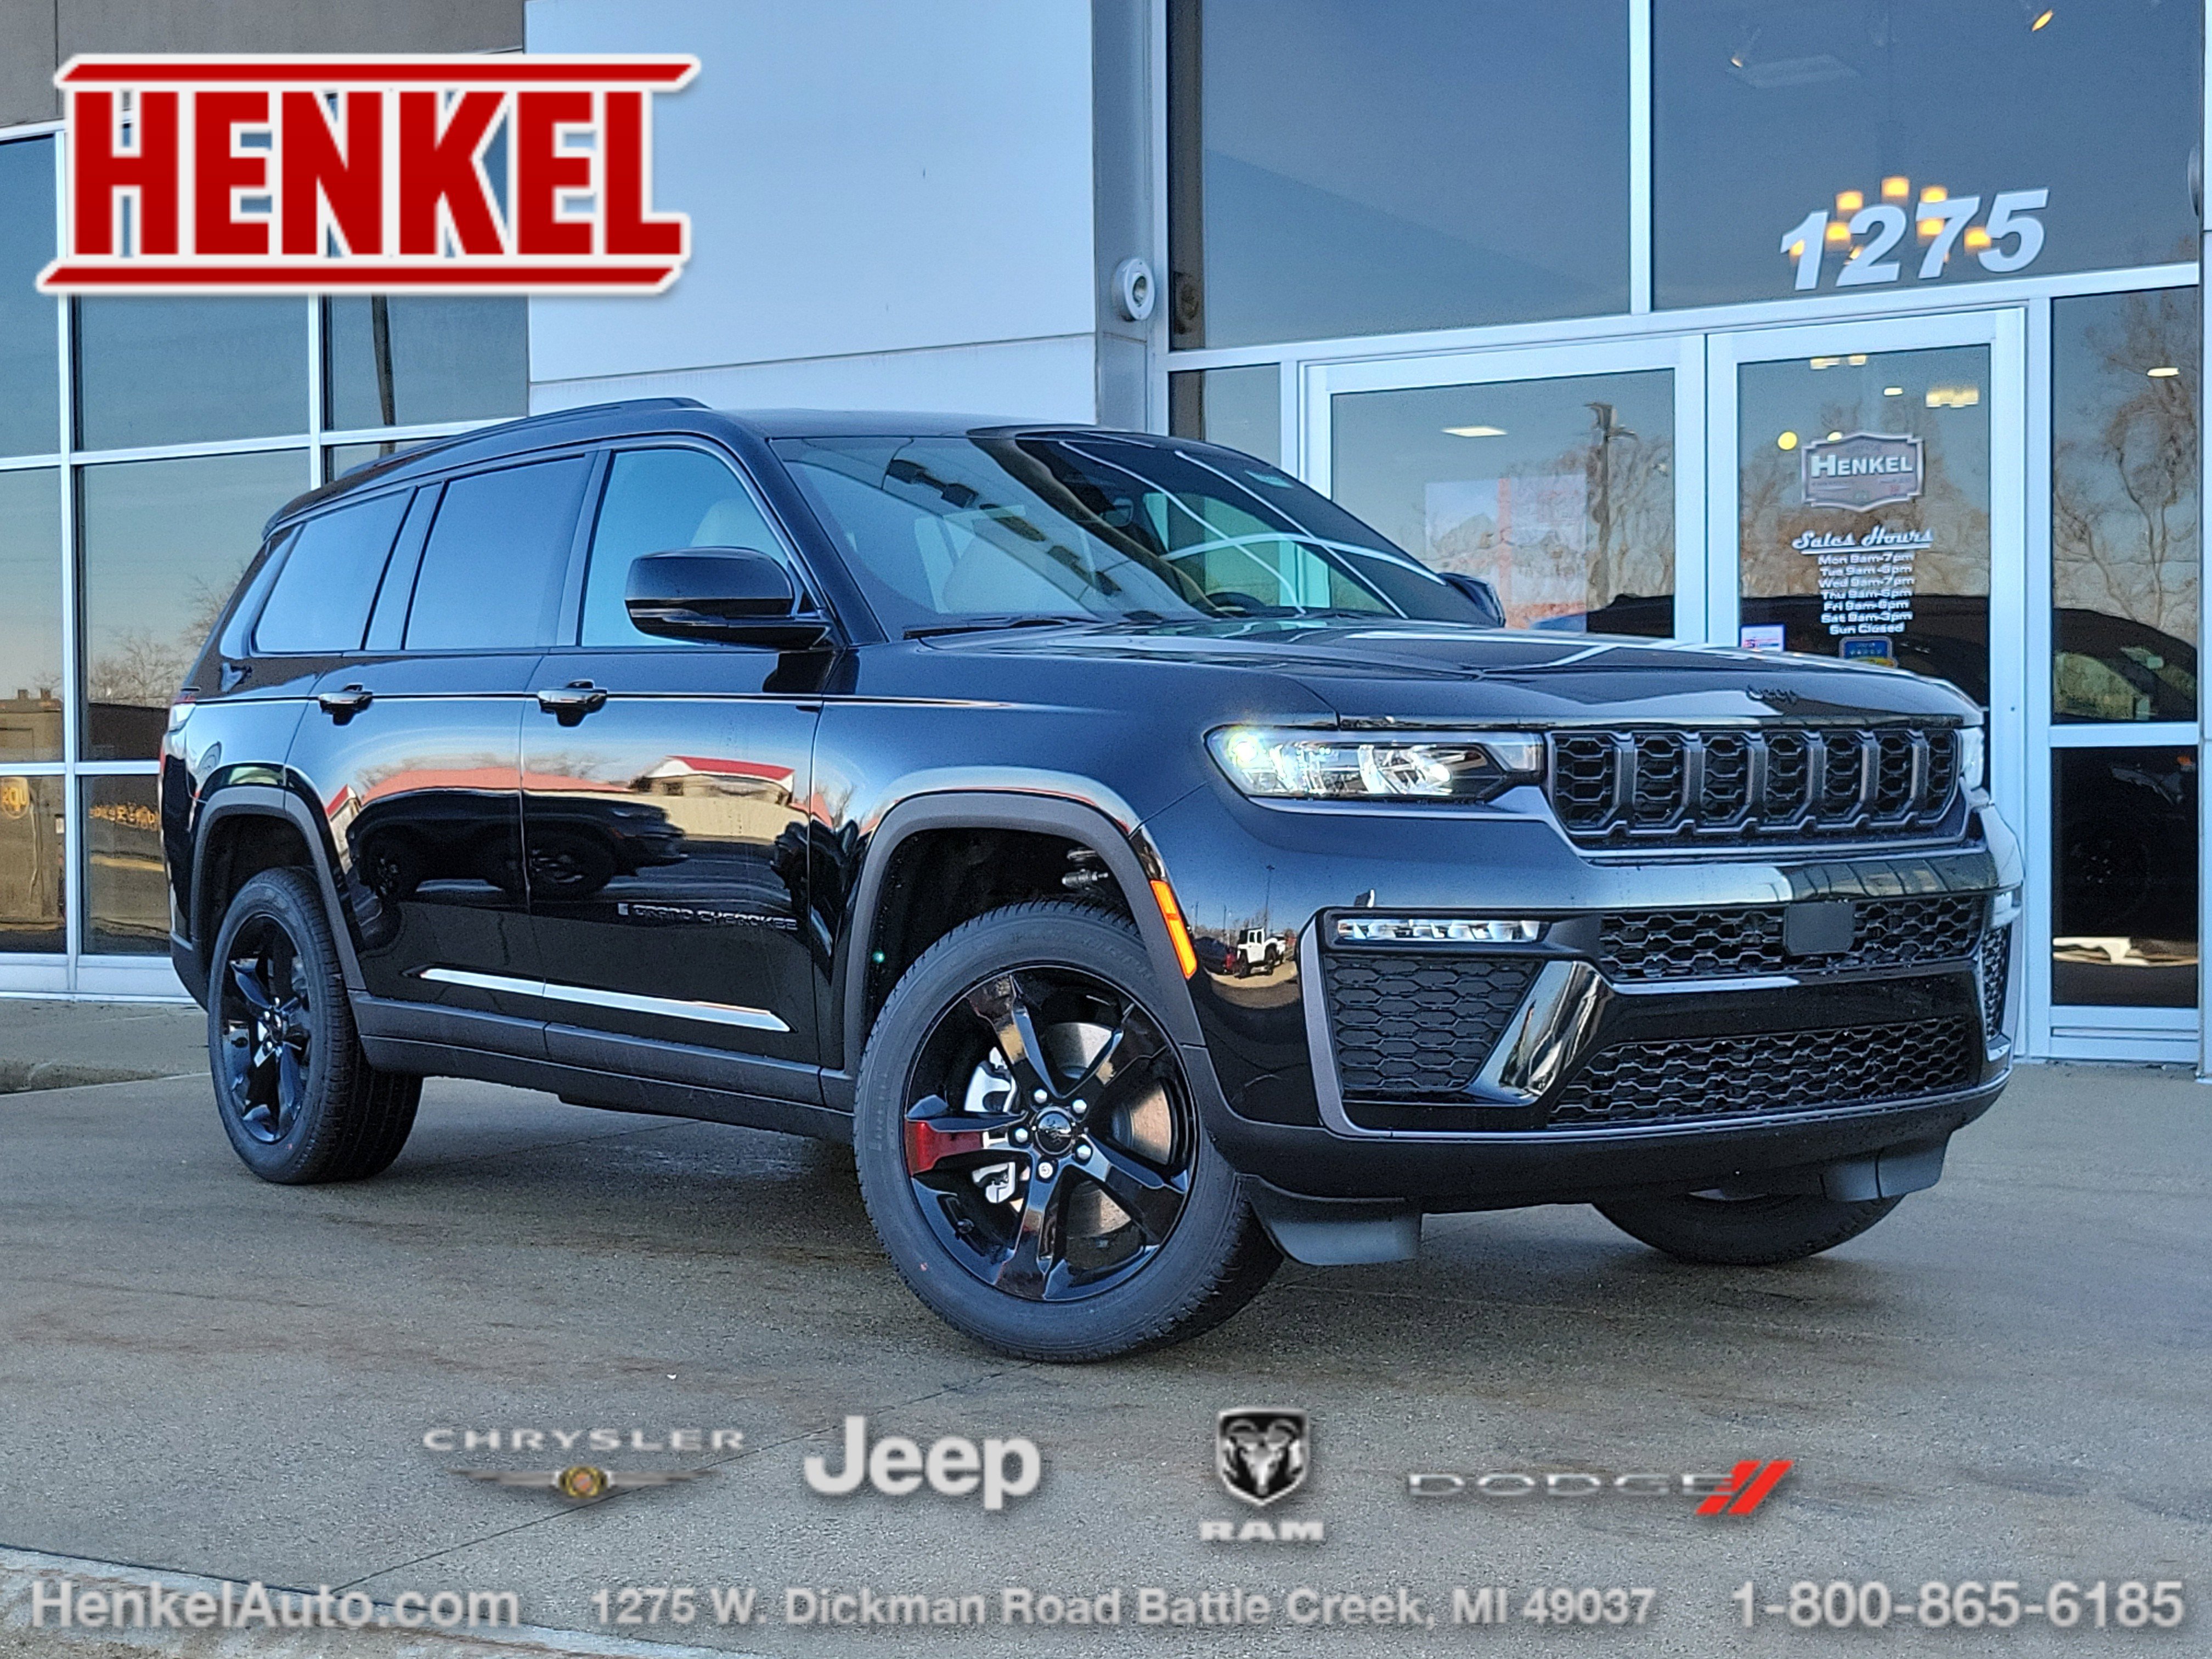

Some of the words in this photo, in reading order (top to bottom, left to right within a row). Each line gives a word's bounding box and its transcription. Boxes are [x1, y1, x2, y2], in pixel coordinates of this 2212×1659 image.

[1780, 188, 2049, 291] 1275
[1811, 454, 1913, 477] HENKEL
[1792, 530, 1855, 549] Sales
[1861, 524, 1934, 547] Hours
[1818, 554, 1848, 565] Mon
[1818, 576, 1849, 588] Wed
[1821, 590, 1846, 600] Thu
[1824, 601, 1843, 611] Fri
[1821, 612, 1846, 623] Sat
[1829, 624, 1856, 635] Sun
[1858, 622, 1905, 633] Closed
